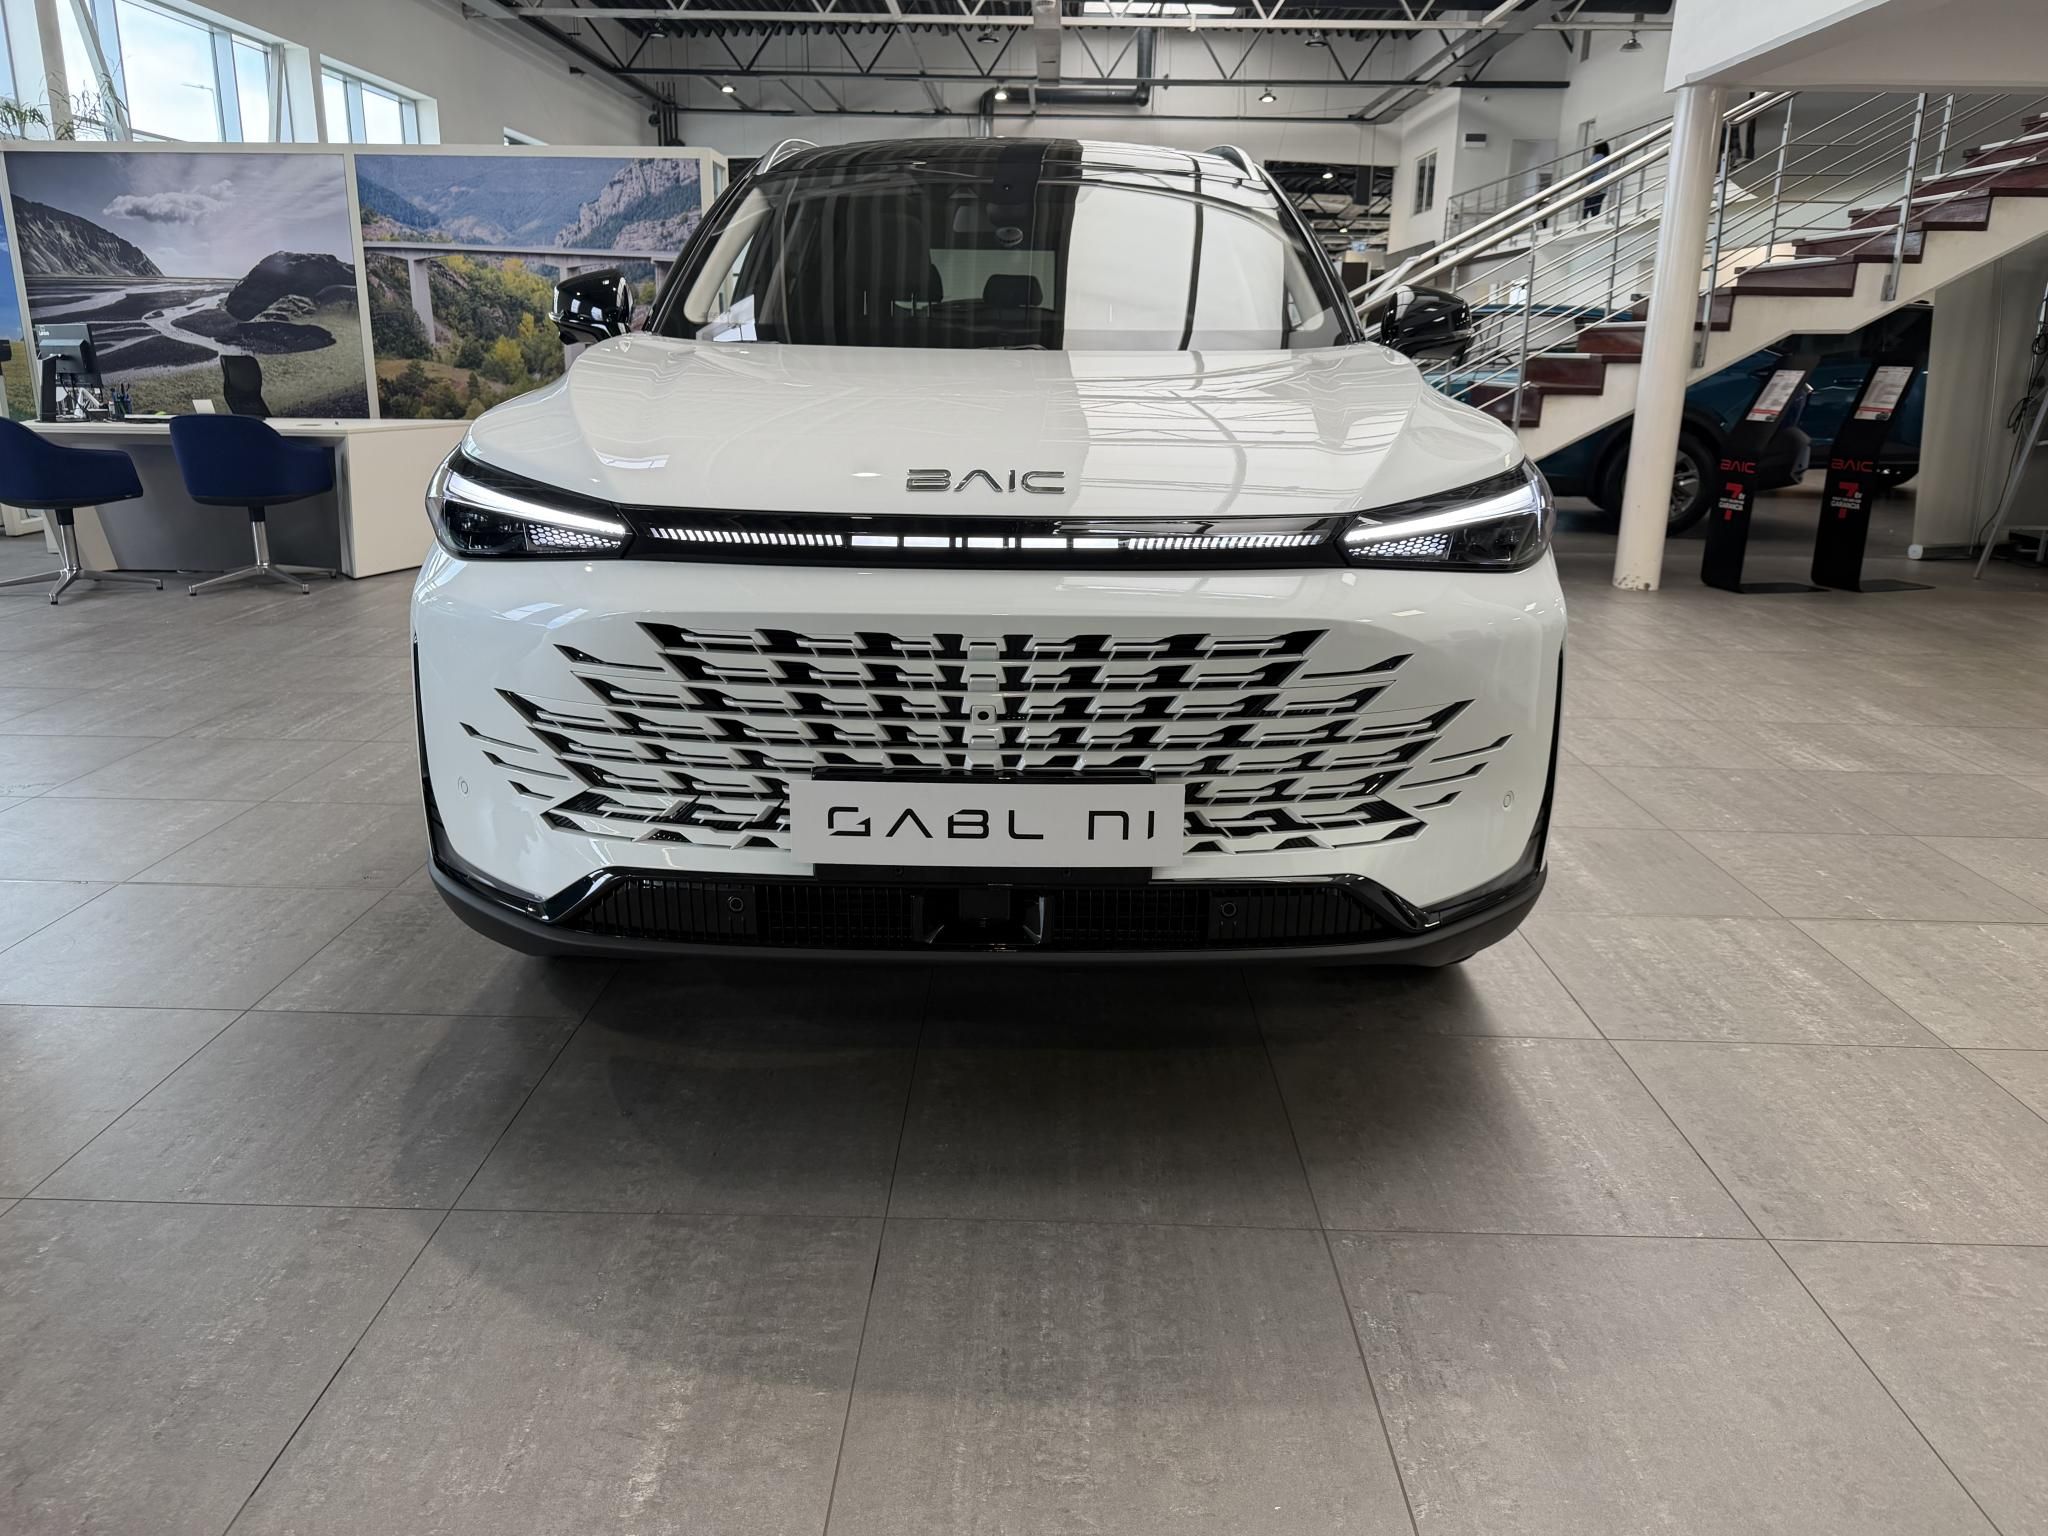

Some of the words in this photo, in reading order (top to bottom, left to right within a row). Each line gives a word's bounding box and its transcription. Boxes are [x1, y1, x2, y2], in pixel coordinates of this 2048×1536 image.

[1720, 459, 1756, 474] BAIC
[1831, 458, 1873, 472] BAIC
[906, 469, 1065, 494] BAIC
